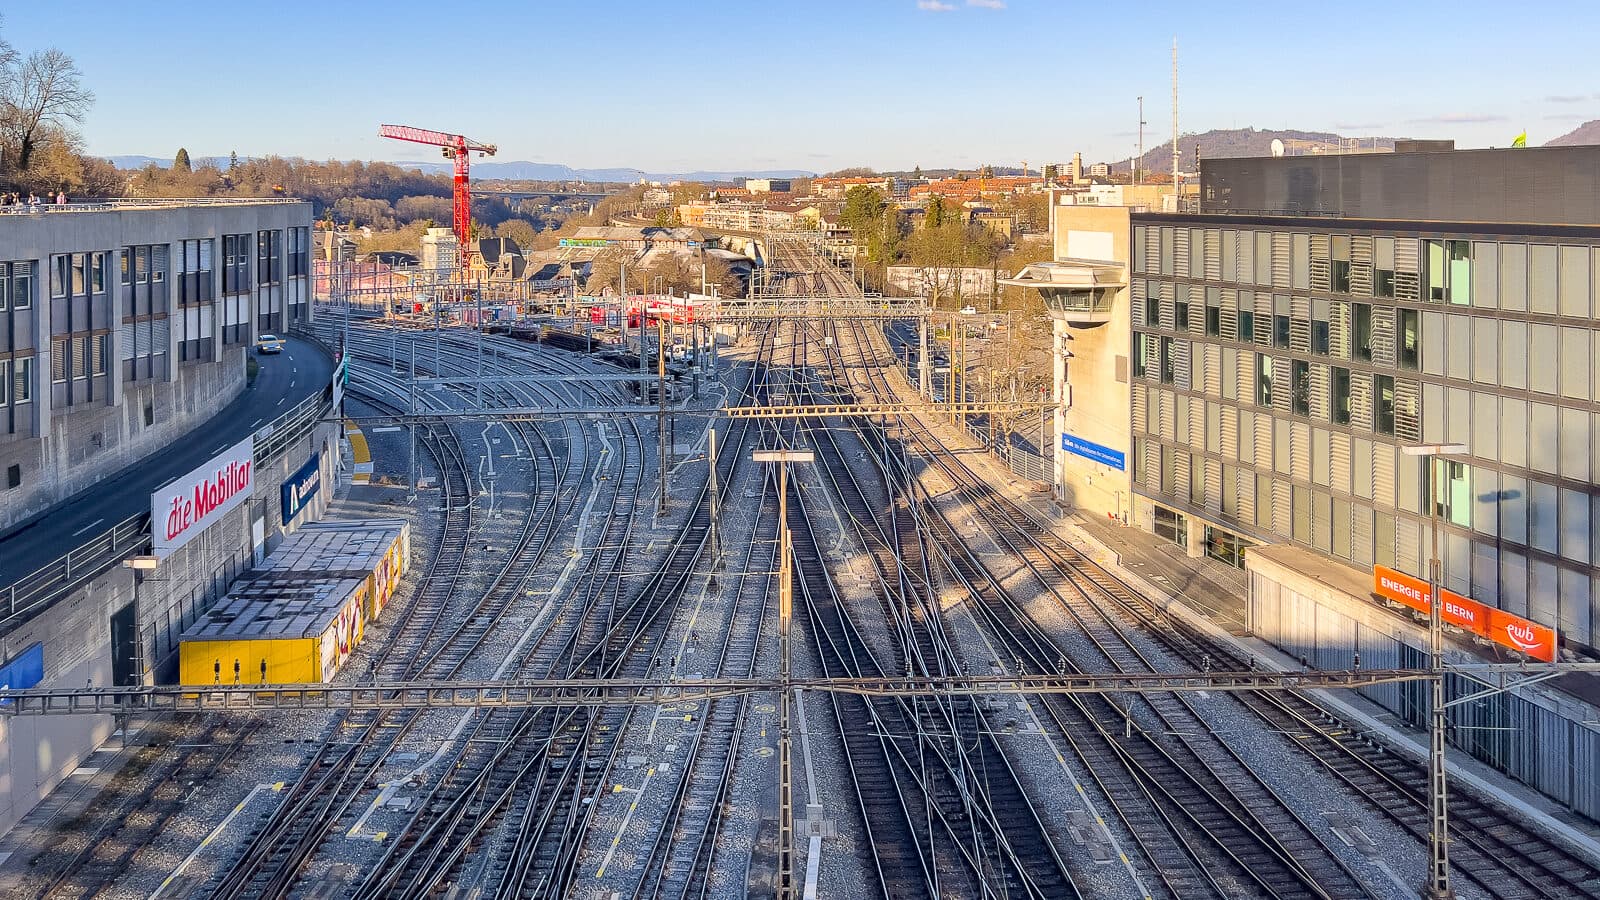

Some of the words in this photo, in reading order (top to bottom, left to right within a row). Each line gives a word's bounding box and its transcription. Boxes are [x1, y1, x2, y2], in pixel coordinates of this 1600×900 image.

[167, 494, 192, 541] die
[194, 459, 251, 523] Mobiliar
[1381, 576, 1421, 601] ENERGIE
[1445, 602, 1474, 622] BERN
[1505, 624, 1540, 647] ewb
